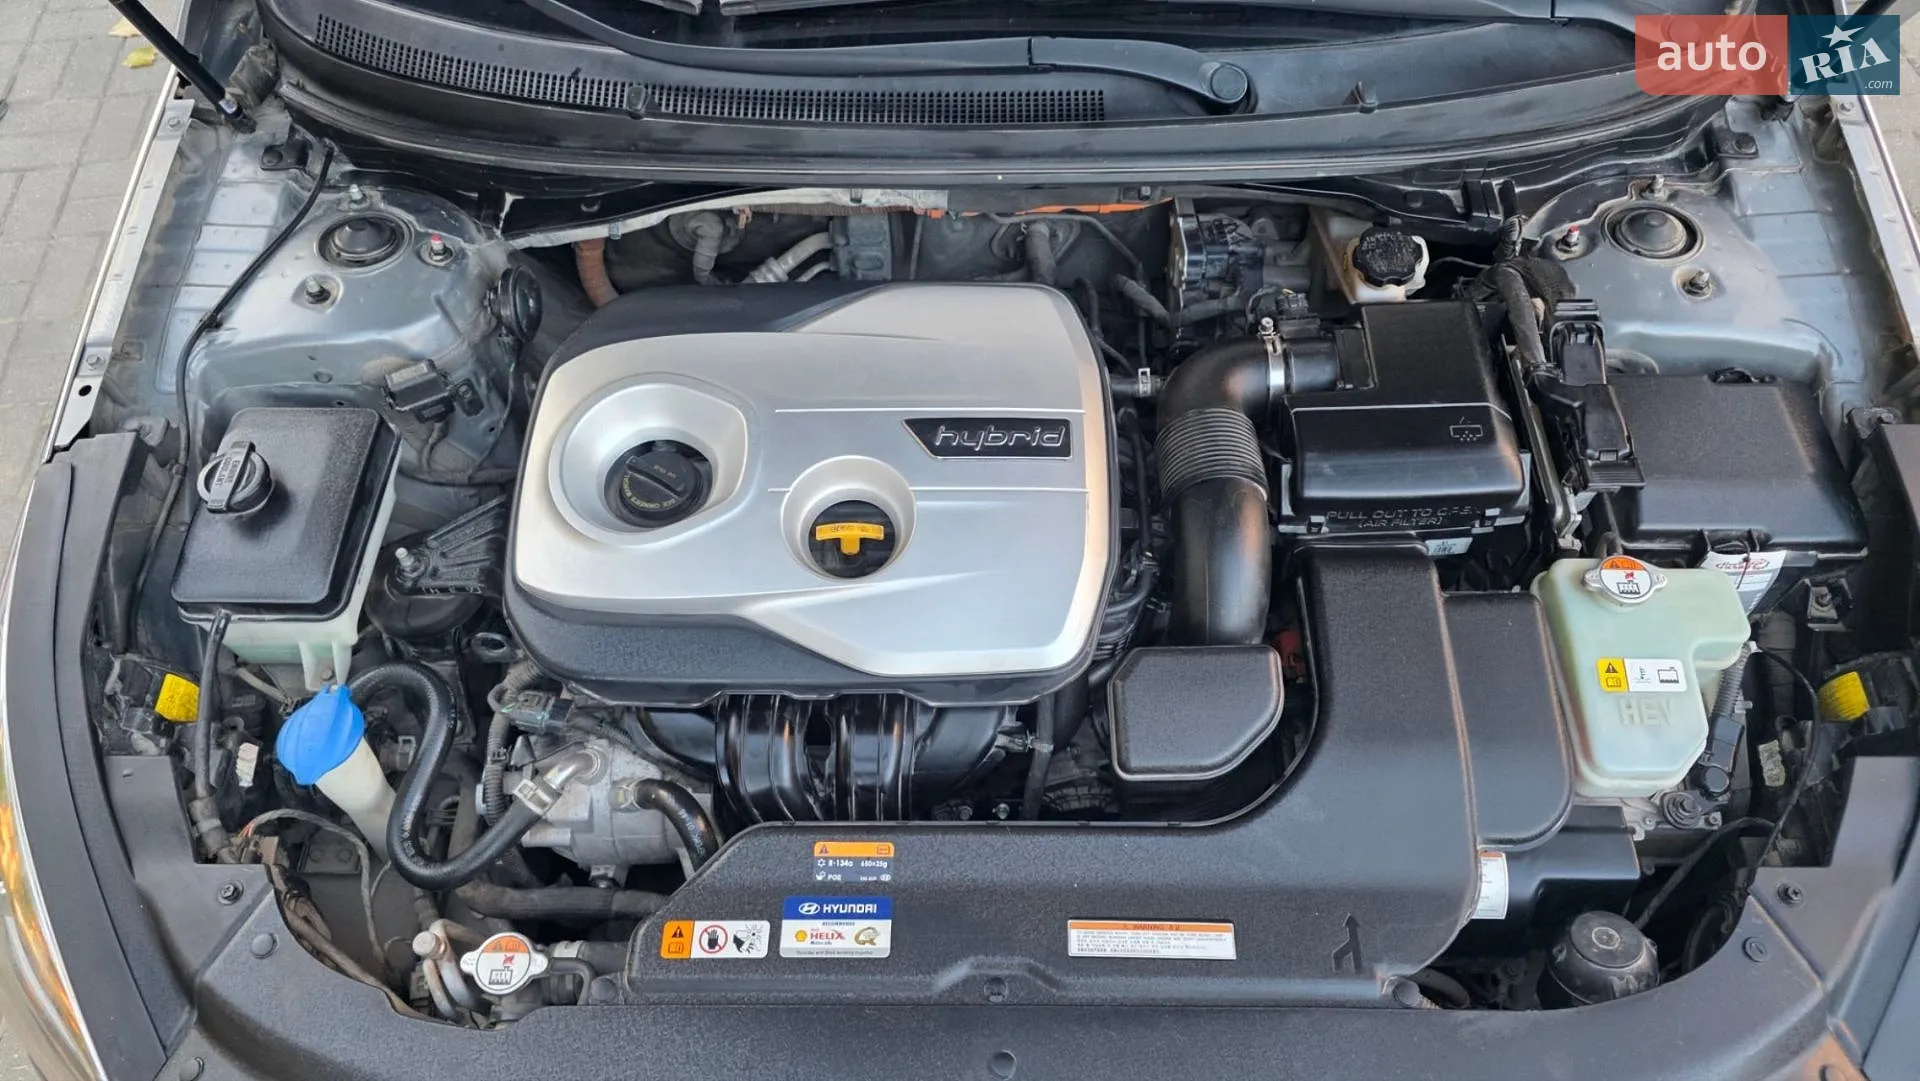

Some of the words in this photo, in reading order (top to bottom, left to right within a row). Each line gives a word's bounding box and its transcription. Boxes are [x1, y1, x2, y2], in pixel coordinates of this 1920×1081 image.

[934, 425, 1066, 451] hybrid
[1326, 510, 1368, 519] PULL
[1372, 509, 1408, 518] OUT
[1411, 508, 1432, 517] TO
[1616, 698, 1671, 726] HEV
[823, 903, 877, 914] HYUNDAI
[810, 930, 845, 940] HELIX
